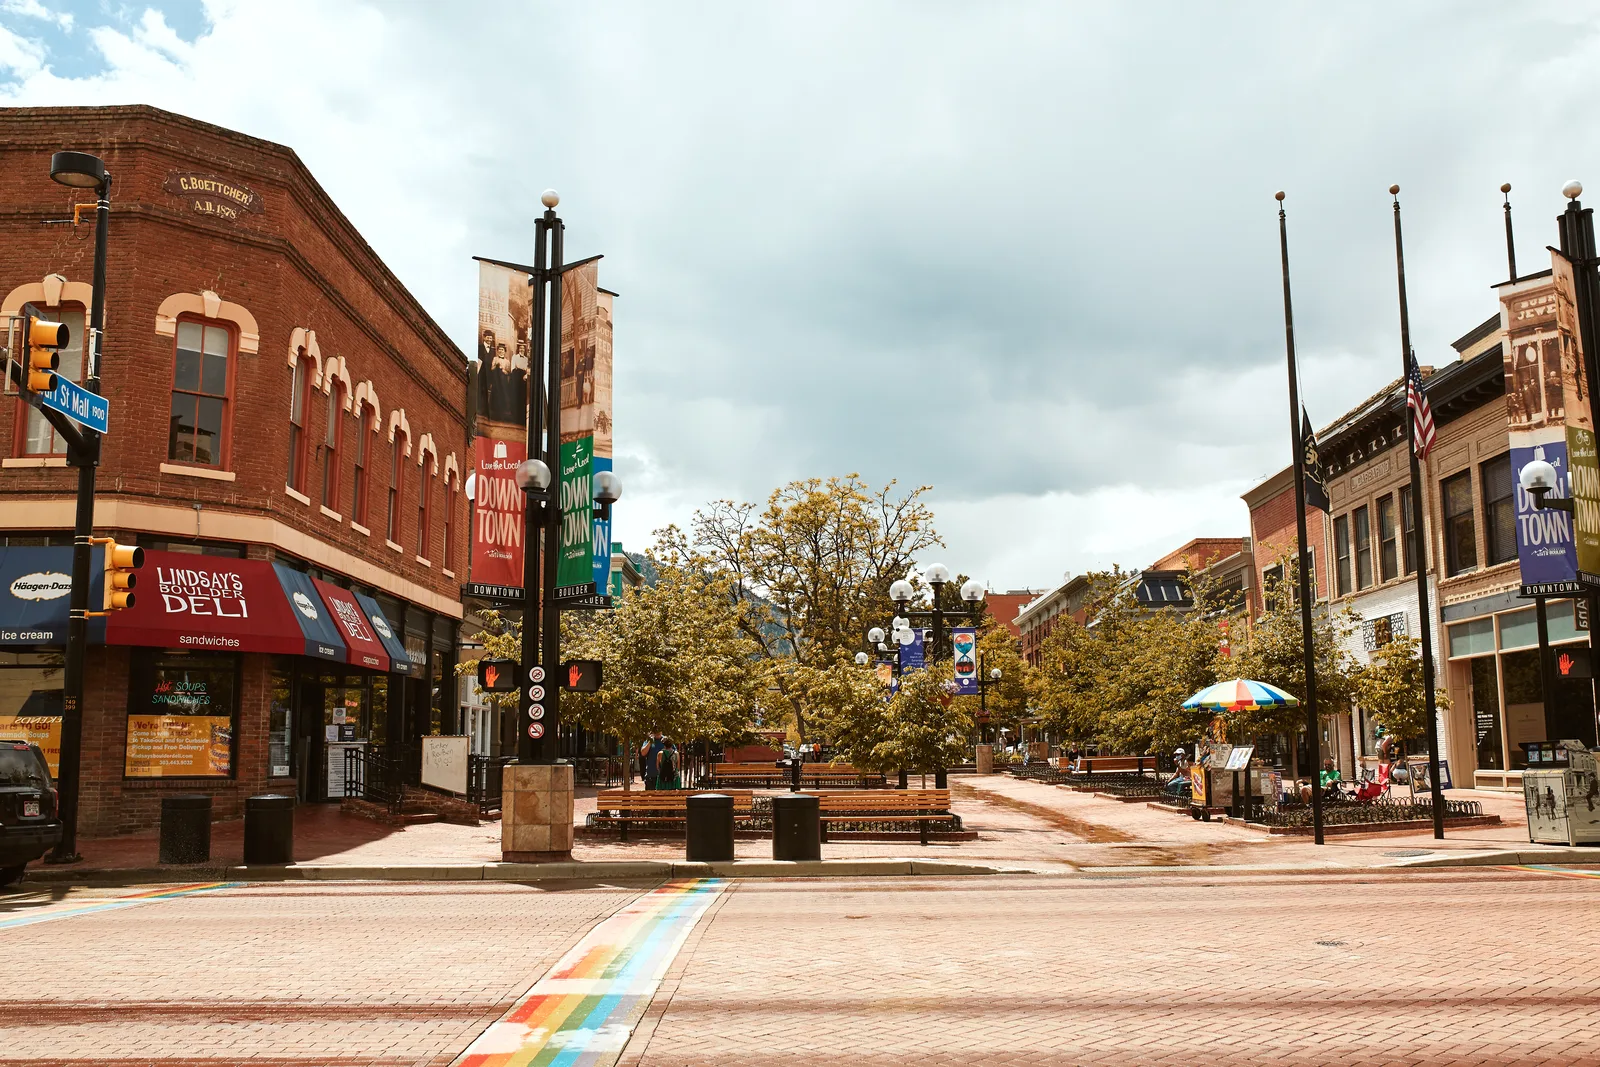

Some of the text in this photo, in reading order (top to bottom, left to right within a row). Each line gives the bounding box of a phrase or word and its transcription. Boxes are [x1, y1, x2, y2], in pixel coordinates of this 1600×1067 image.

[217, 204, 237, 219] 1878
[60, 384, 69, 409] St
[72, 391, 89, 419] Mall
[92, 405, 105, 421] 1900
[478, 474, 521, 511] DOWN
[477, 508, 521, 548] TOWN
[1518, 510, 1571, 547] TOWN
[156, 567, 244, 591] LINDSAY'S
[158, 583, 246, 600] BOULDER
[474, 584, 520, 598] DOWNTOWN
[558, 584, 588, 598] BOULDER
[1526, 582, 1580, 595] DOWNTOWN
[161, 594, 249, 619] DELI
[1, 630, 54, 640] ice cream
[179, 634, 241, 648] sandwiches
[175, 681, 207, 692] SOUPS
[34, 722, 51, 731] GO!
[133, 721, 159, 730] We're
[28, 730, 49, 739] Soups
[178, 744, 205, 753] Delivery!
